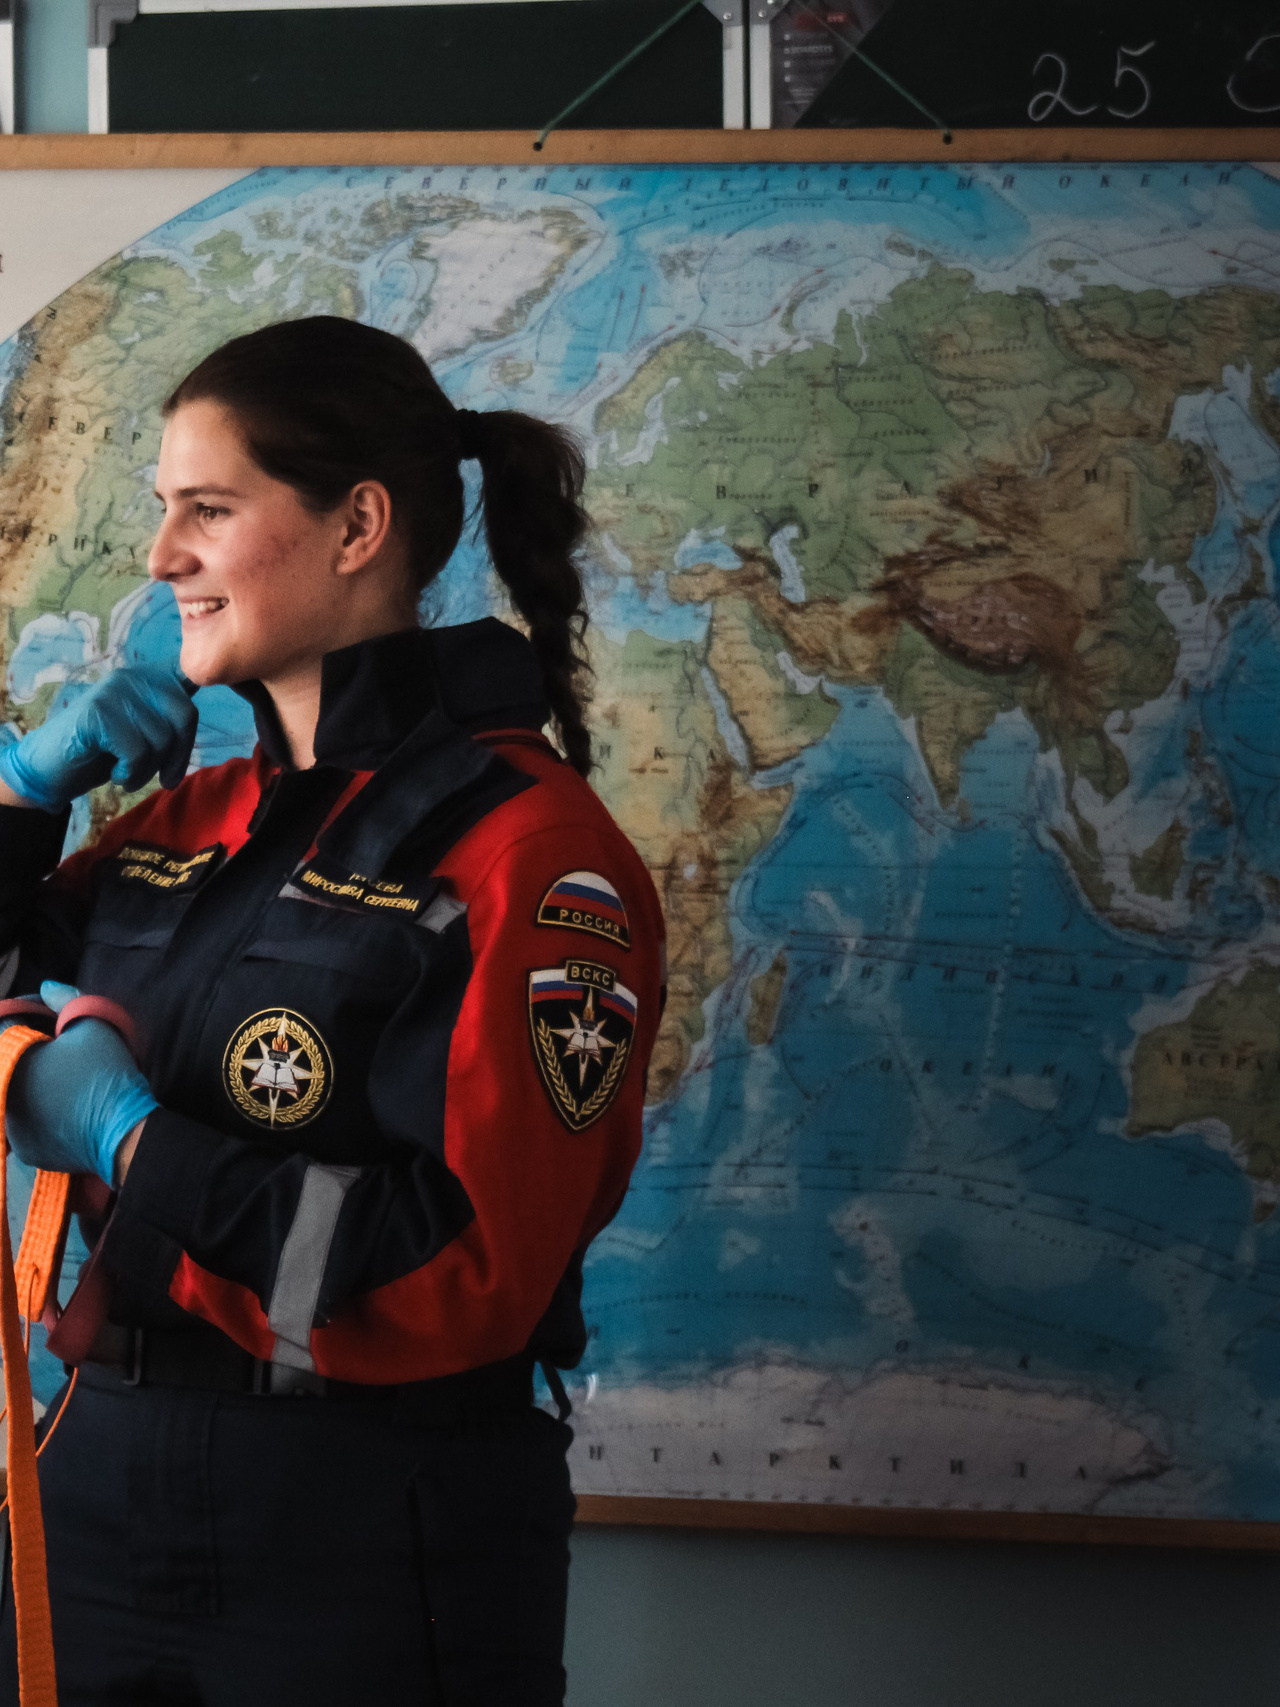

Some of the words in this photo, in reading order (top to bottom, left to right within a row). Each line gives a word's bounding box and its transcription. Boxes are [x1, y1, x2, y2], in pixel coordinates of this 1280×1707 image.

[1027, 40, 1155, 122] 25
[559, 908, 621, 938] РОССИЯ
[570, 964, 611, 987] ВСКС
